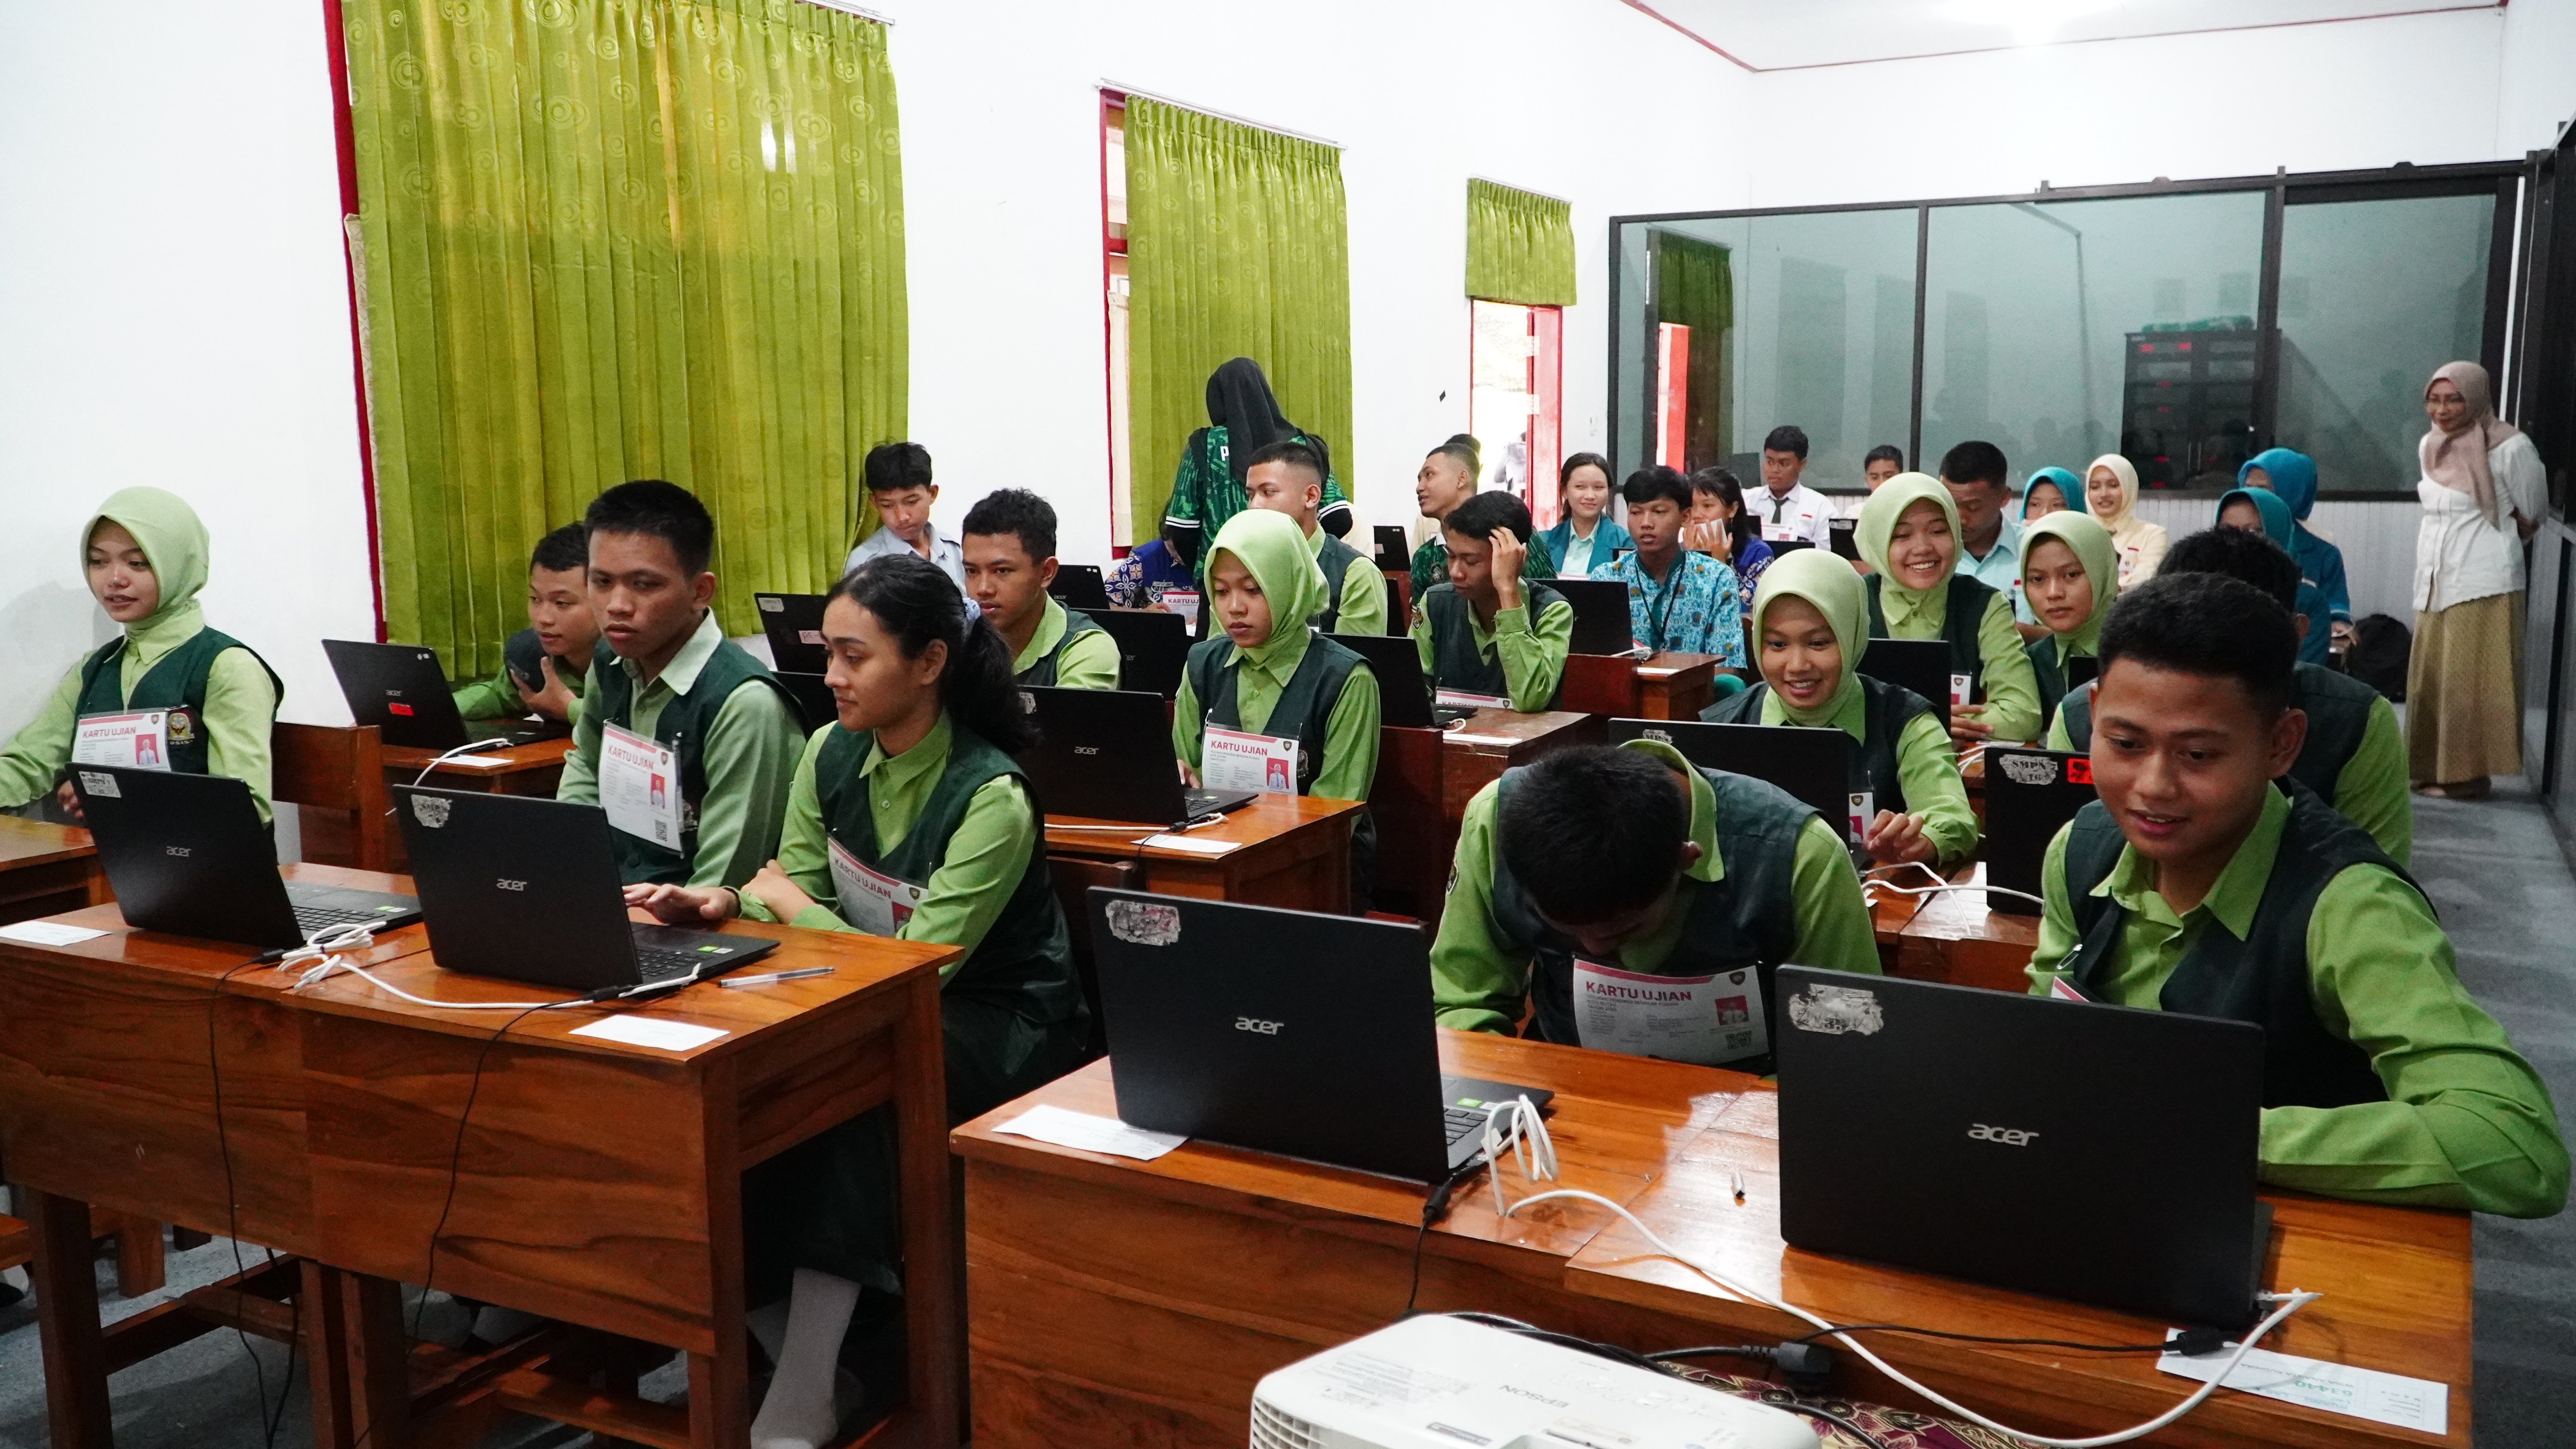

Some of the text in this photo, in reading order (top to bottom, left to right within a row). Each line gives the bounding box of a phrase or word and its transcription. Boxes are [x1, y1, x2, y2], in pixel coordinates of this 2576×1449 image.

[82, 726, 136, 738] KARTU UJIAN
[1074, 746, 1099, 755] acer
[1211, 740, 1268, 756] KARTU UJIAN
[608, 745, 653, 770] KARTU UJIAN
[167, 846, 191, 857] acer
[497, 879, 527, 891] acer
[835, 858, 891, 899] KARTU UJIAN
[1586, 981, 1692, 1001] KARTU UJIAN
[1235, 1017, 1284, 1035] acer
[1968, 1123, 2039, 1146] acer
[1498, 1385, 1570, 1408] EPSON
[2295, 1379, 2353, 1397] 63440
